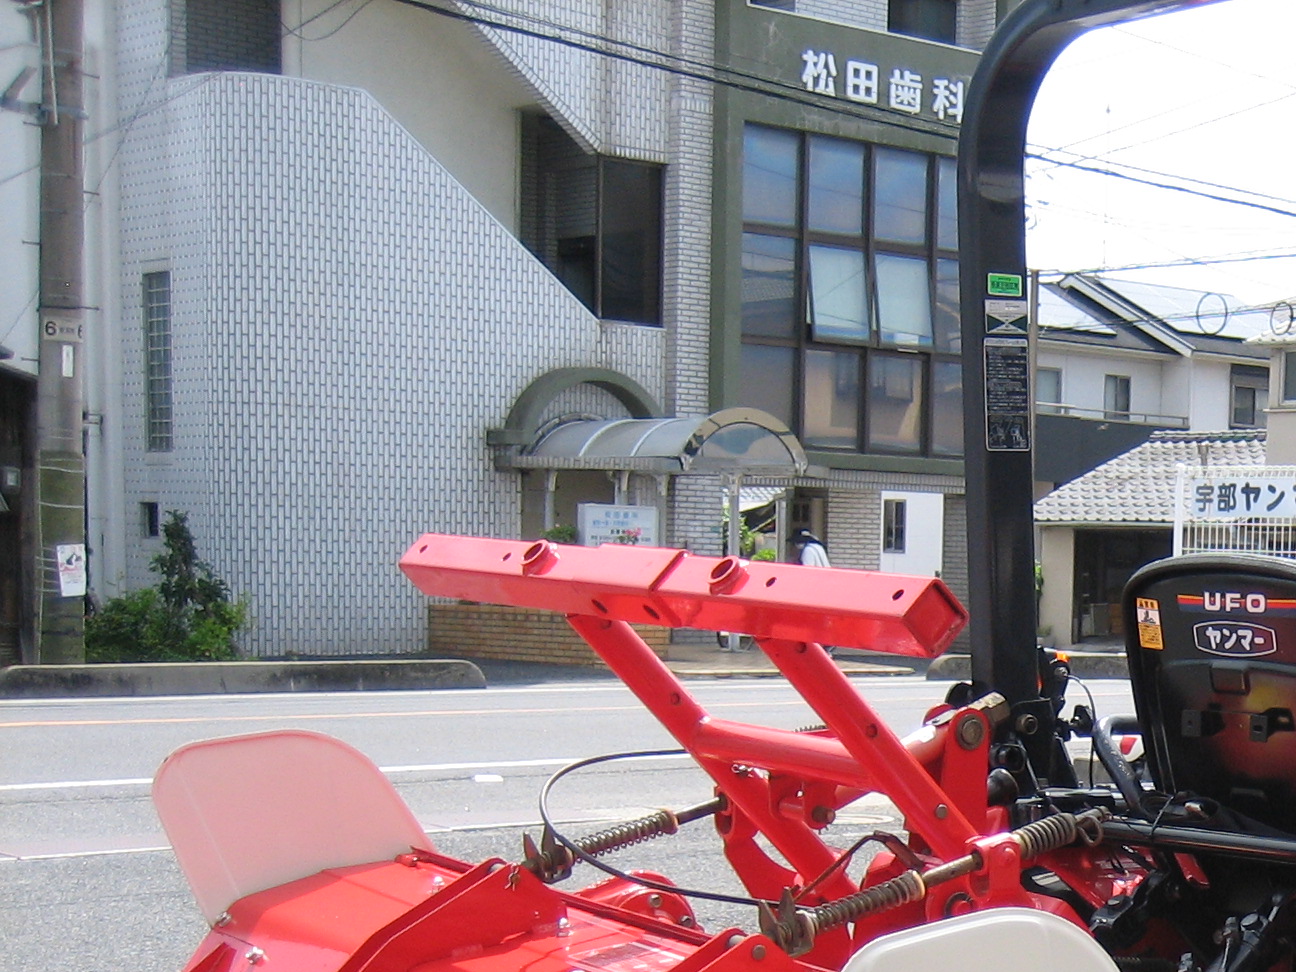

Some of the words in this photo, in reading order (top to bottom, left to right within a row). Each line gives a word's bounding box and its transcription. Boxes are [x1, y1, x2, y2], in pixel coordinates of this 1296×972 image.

[802, 49, 964, 124] 松田歯科
[45, 321, 56, 336] 6
[1203, 591, 1266, 613] UFO
[1205, 626, 1265, 650] ヤンマー
